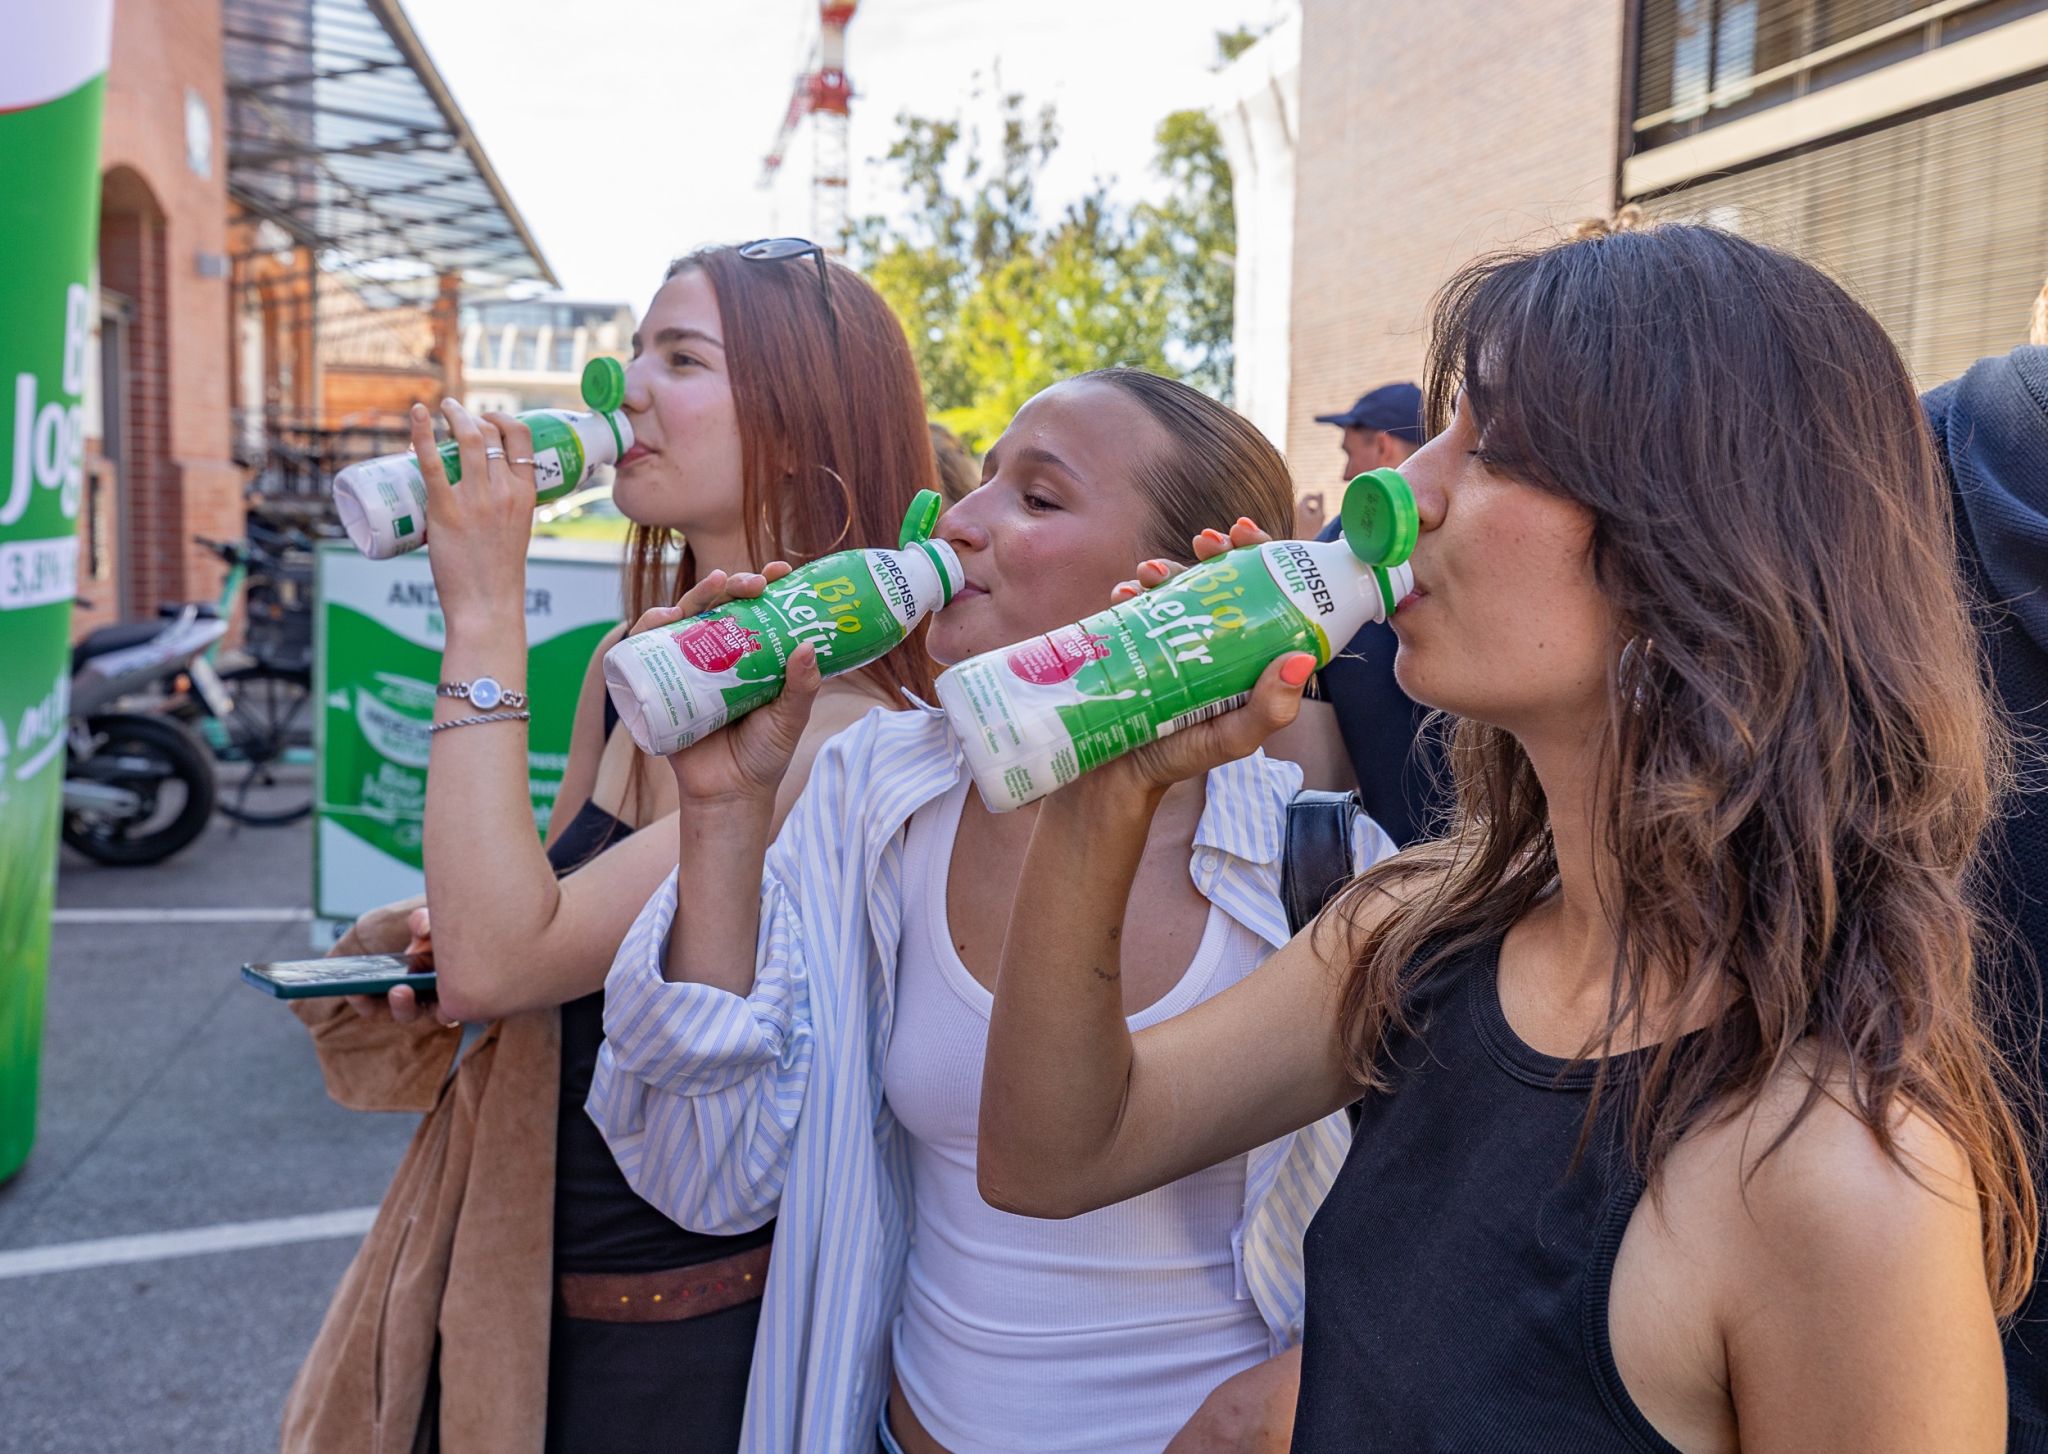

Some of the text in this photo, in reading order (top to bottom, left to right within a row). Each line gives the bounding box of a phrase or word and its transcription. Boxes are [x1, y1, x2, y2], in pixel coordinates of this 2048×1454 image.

[873, 563, 902, 607] NATUR
[873, 551, 917, 620] ANDECHSER
[1269, 547, 1306, 594] NATUR
[772, 582, 838, 657] Kefir
[814, 576, 862, 633] Bio
[1184, 563, 1248, 629] Bio
[719, 617, 750, 650] E-ROLLER
[723, 632, 740, 651] SUP
[750, 605, 787, 668] mild fettarm
[1064, 640, 1083, 658] SUP
[1118, 628, 1148, 679] fettarm
[662, 671, 675, 691] Protein
